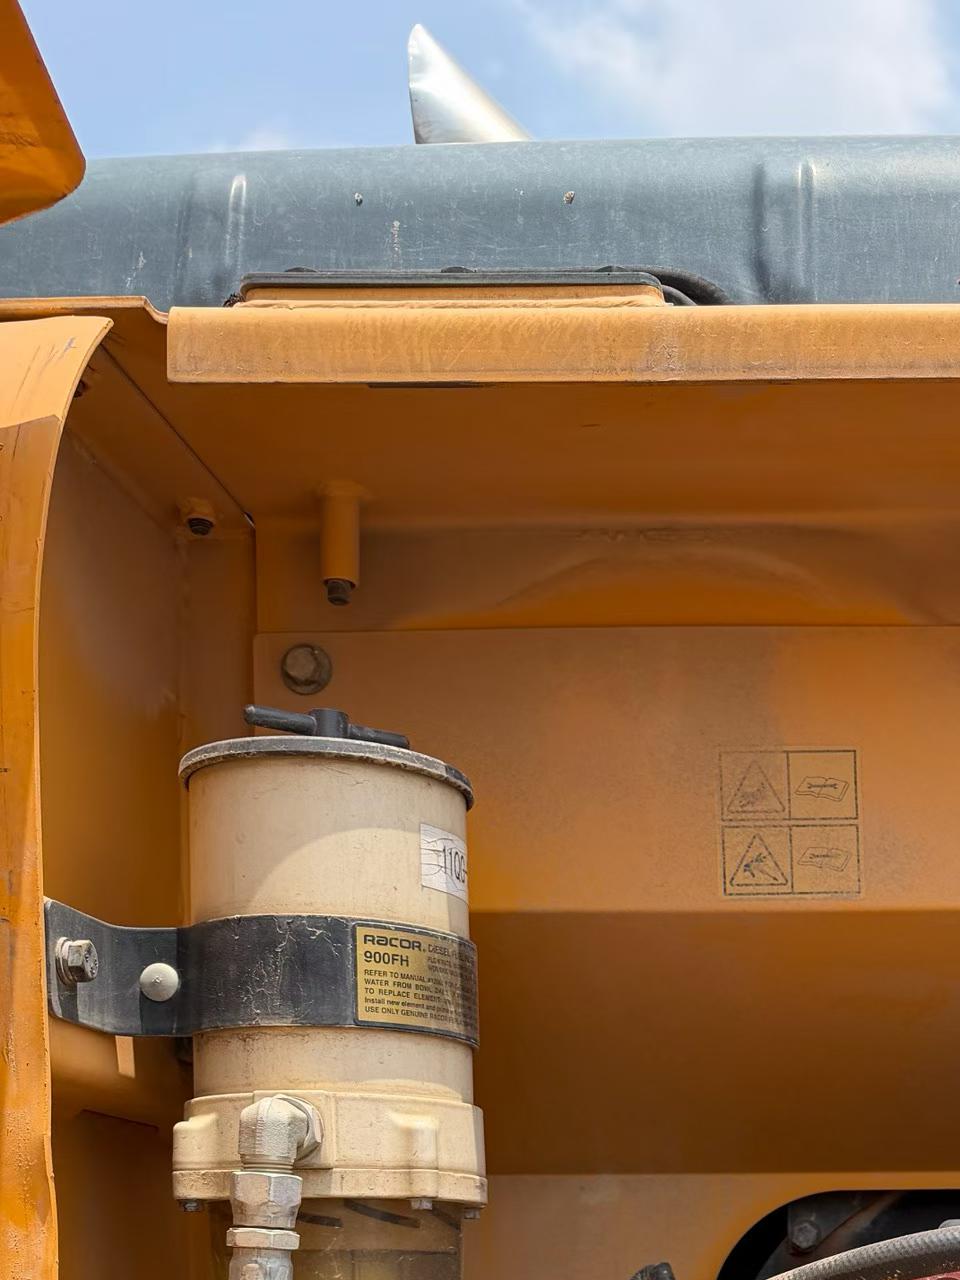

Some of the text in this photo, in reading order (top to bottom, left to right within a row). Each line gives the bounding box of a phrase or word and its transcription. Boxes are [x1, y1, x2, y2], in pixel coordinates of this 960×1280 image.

[363, 950, 410, 967] 900FH
[363, 968, 388, 978] REFER
[389, 971, 400, 979] TO
[400, 972, 426, 983] MANUAL
[363, 977, 390, 987] WATER
[392, 980, 412, 989] FROM
[364, 987, 375, 995] TO
[378, 988, 411, 999] REPLACE
[364, 1005, 380, 1014] USE
[381, 1006, 400, 1015] ONLY
